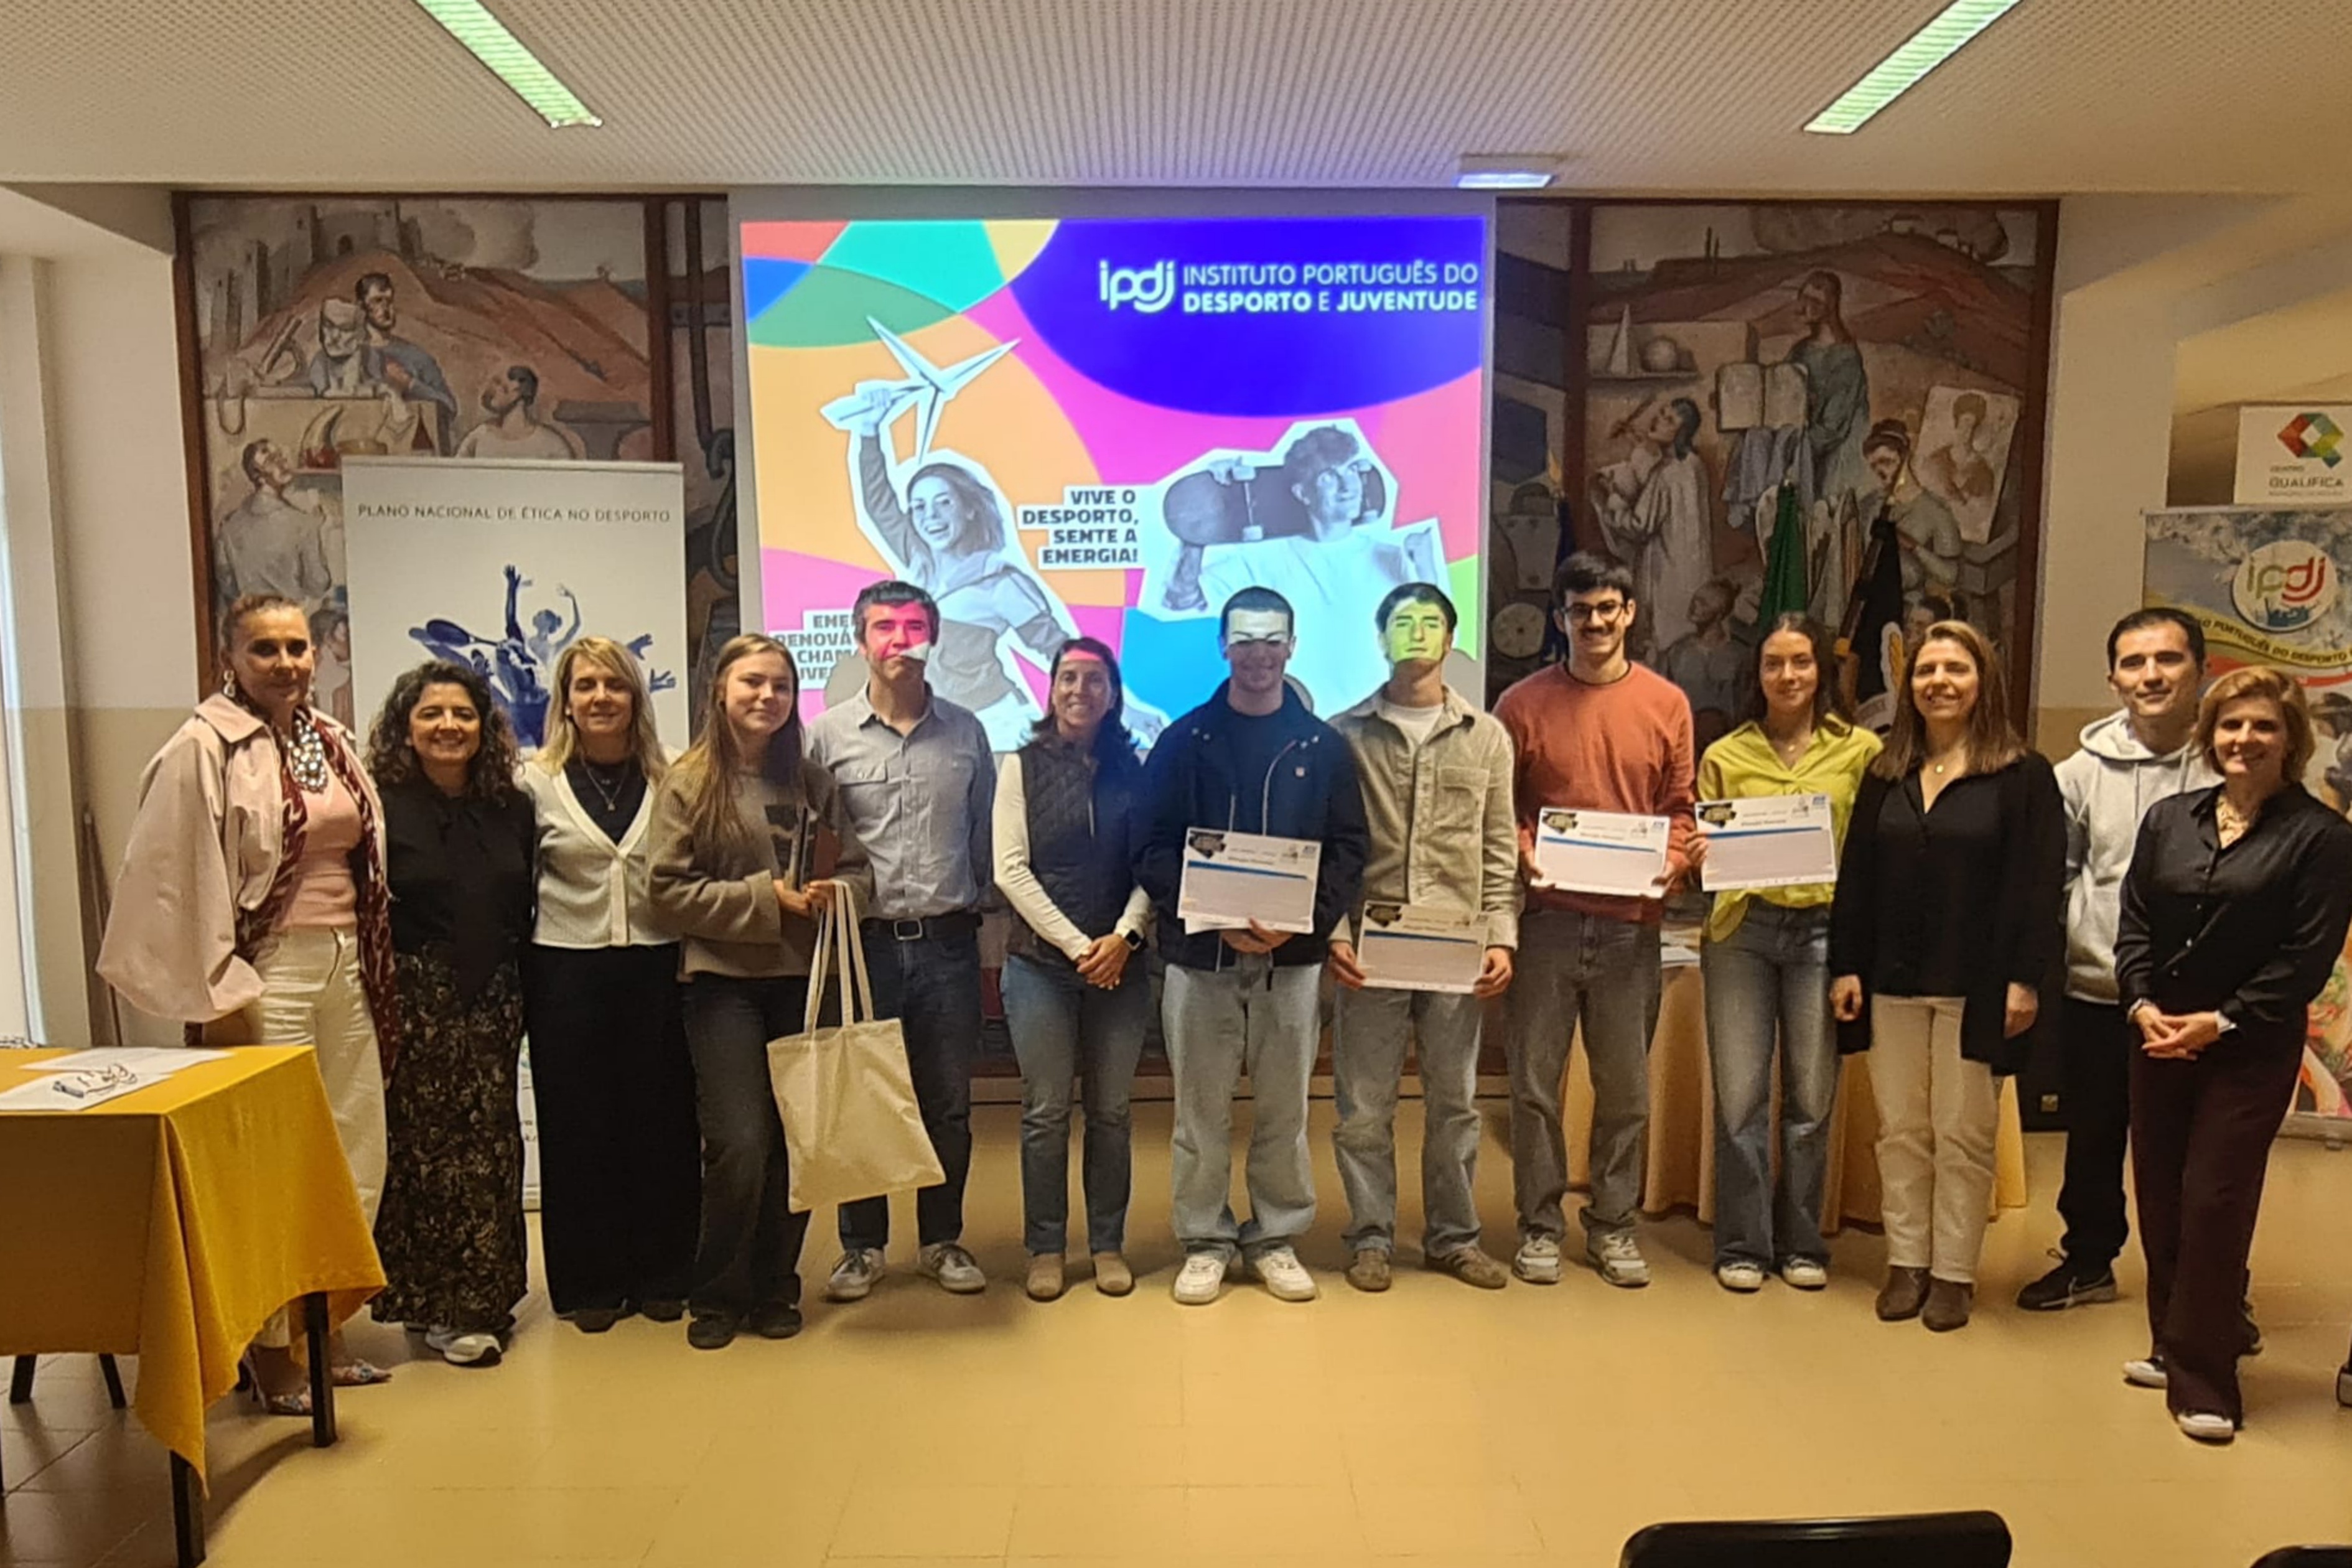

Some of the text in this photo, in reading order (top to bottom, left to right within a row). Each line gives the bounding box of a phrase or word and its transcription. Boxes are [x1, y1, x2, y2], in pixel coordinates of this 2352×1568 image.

[1183, 259, 1478, 286] INSTITUTO PORTUGUÊS DO
[1099, 260, 1175, 312] ipdj
[1183, 291, 1477, 312] DESPORTO E JUVENTUDE
[2269, 476, 2343, 488] QUALIFICA
[1071, 490, 1136, 505] VIVE O
[358, 503, 670, 522] PLANO NACIONAL DE ÉTICA NO DESPORTO
[1023, 508, 1139, 525] DESPORTO,
[1053, 529, 1137, 544] SENTE A
[1042, 548, 1139, 564] ENERGIA!
[2247, 556, 2326, 602] ipdj
[813, 614, 856, 628] ENE
[775, 628, 852, 646] RENOVÁ
[2272, 646, 2289, 656] DO
[2290, 650, 2347, 663] DESPORTO
